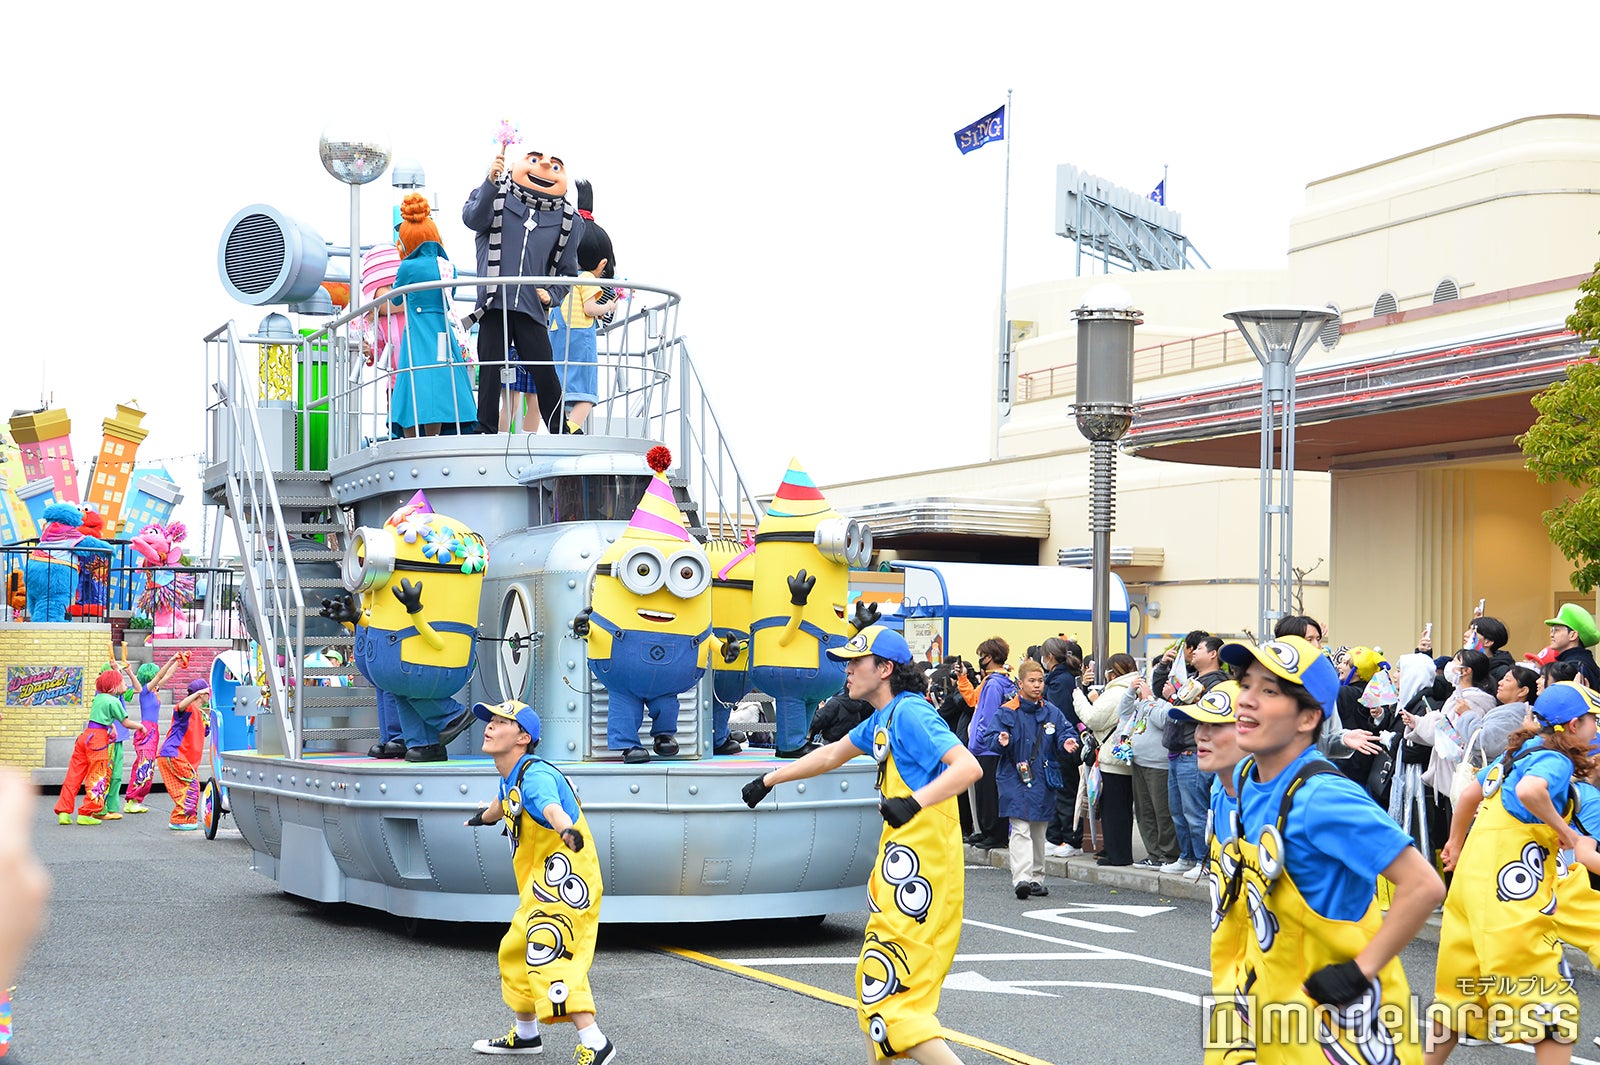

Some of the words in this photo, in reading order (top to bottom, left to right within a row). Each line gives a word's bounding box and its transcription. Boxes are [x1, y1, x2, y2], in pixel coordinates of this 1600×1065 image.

[960, 117, 1002, 148] SING
[7, 666, 57, 692] Dance!
[19, 672, 69, 699] Dance!
[32, 680, 80, 706] Dance!
